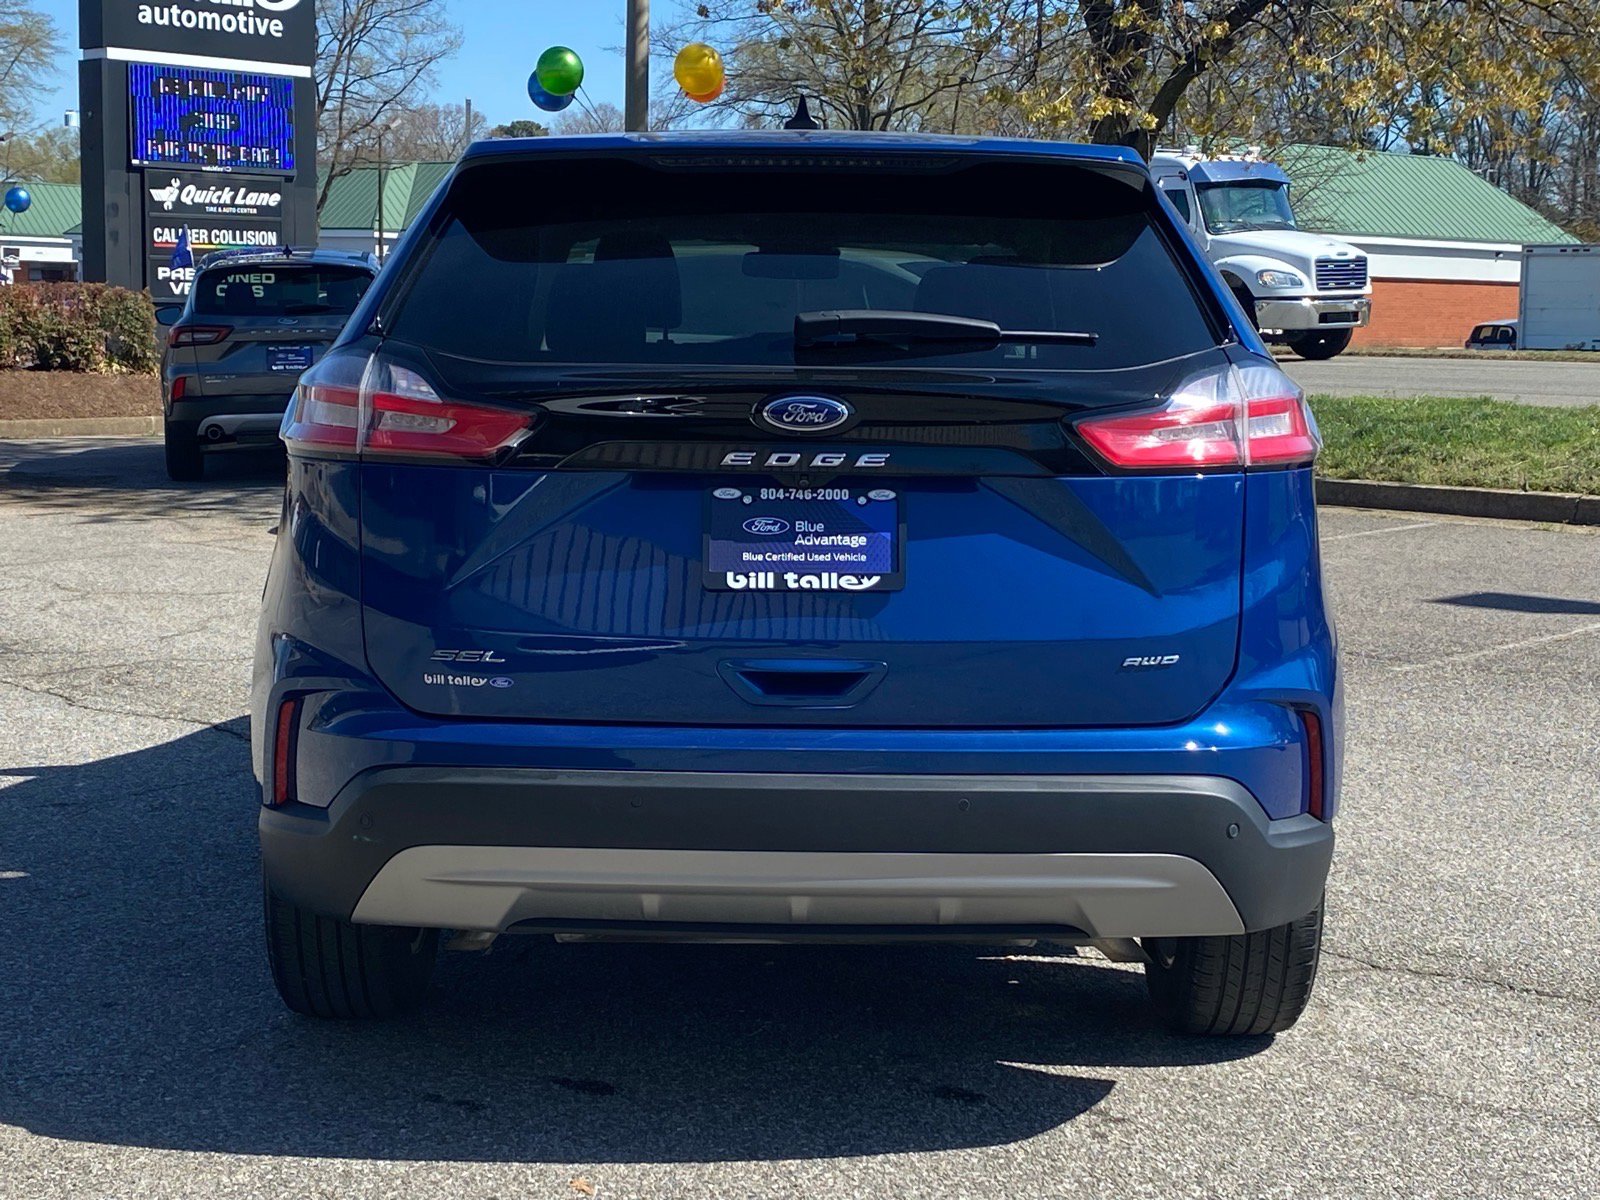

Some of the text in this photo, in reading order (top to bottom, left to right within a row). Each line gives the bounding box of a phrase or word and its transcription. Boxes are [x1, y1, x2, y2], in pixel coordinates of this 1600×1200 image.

[137, 4, 284, 38] automotive
[180, 184, 281, 207] Quick Lane
[153, 227, 277, 246] CALBER COLLISION
[782, 403, 828, 424] Ford
[720, 452, 891, 468] EDGE
[760, 488, 849, 500] 804-746-2000
[751, 519, 825, 532] Ford Blue
[794, 534, 867, 548] Advantage
[742, 552, 867, 562] Blue Certified Used Vehicle
[726, 571, 881, 590] bill talley
[430, 649, 506, 663] SEL
[1122, 654, 1180, 667] AWD
[424, 673, 445, 685] bill
[447, 675, 488, 687] talley
